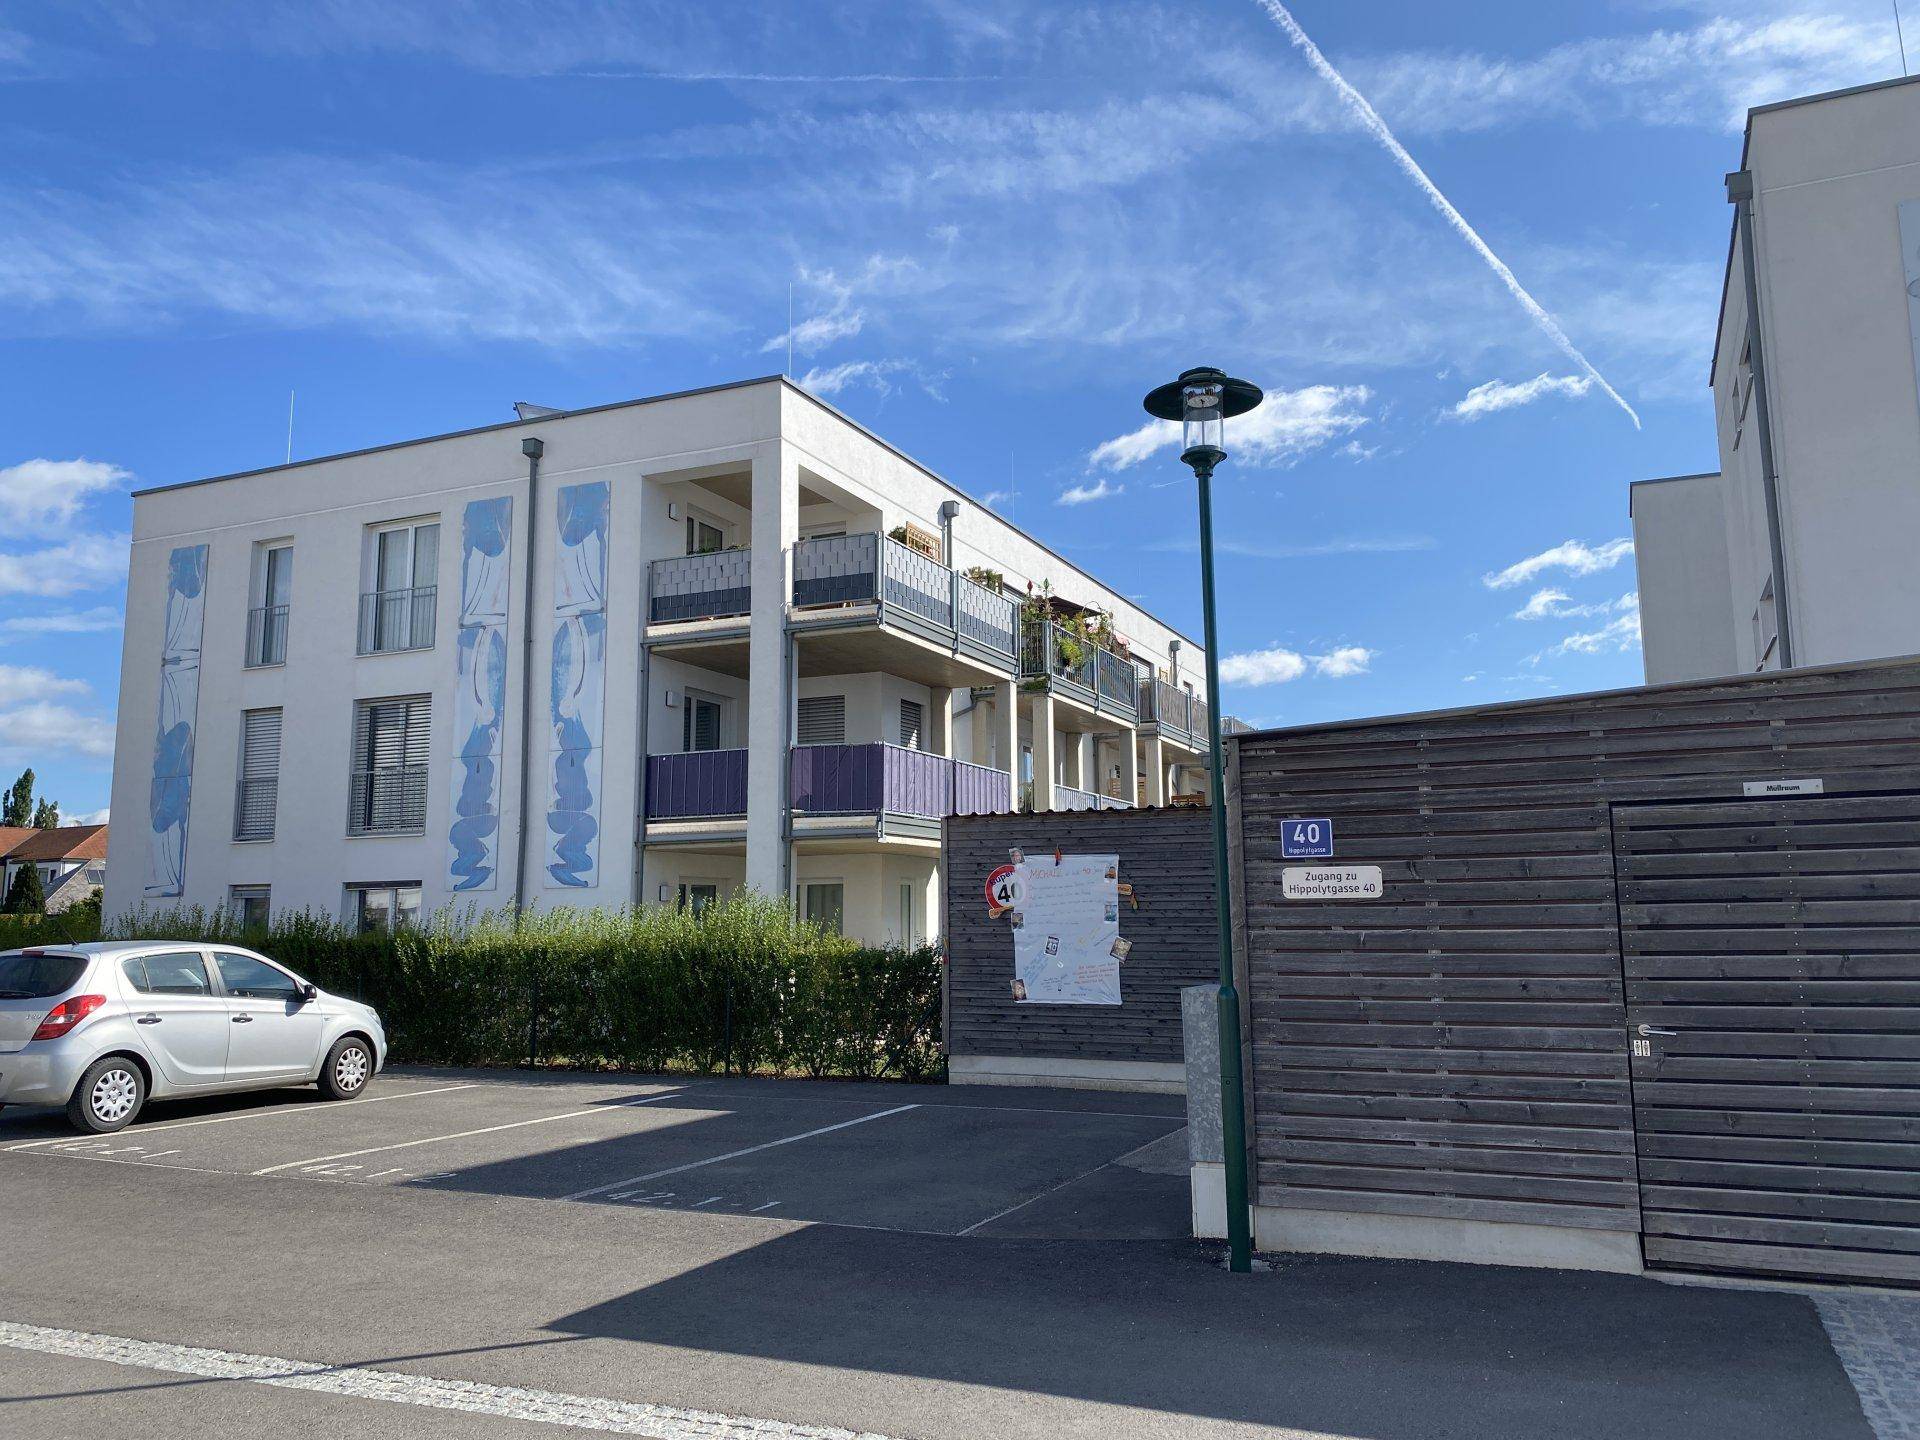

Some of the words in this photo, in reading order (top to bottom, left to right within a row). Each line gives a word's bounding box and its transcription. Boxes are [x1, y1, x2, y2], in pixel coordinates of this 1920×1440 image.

[1766, 784, 1800, 792] Müllraum
[1293, 823, 1320, 843] 40
[1288, 846, 1326, 854] Hippolytgasse
[1305, 872, 1342, 882] Zugang
[1345, 872, 1357, 880] zu
[1289, 884, 1360, 895] Hippolytgasse
[1363, 883, 1376, 893] 40
